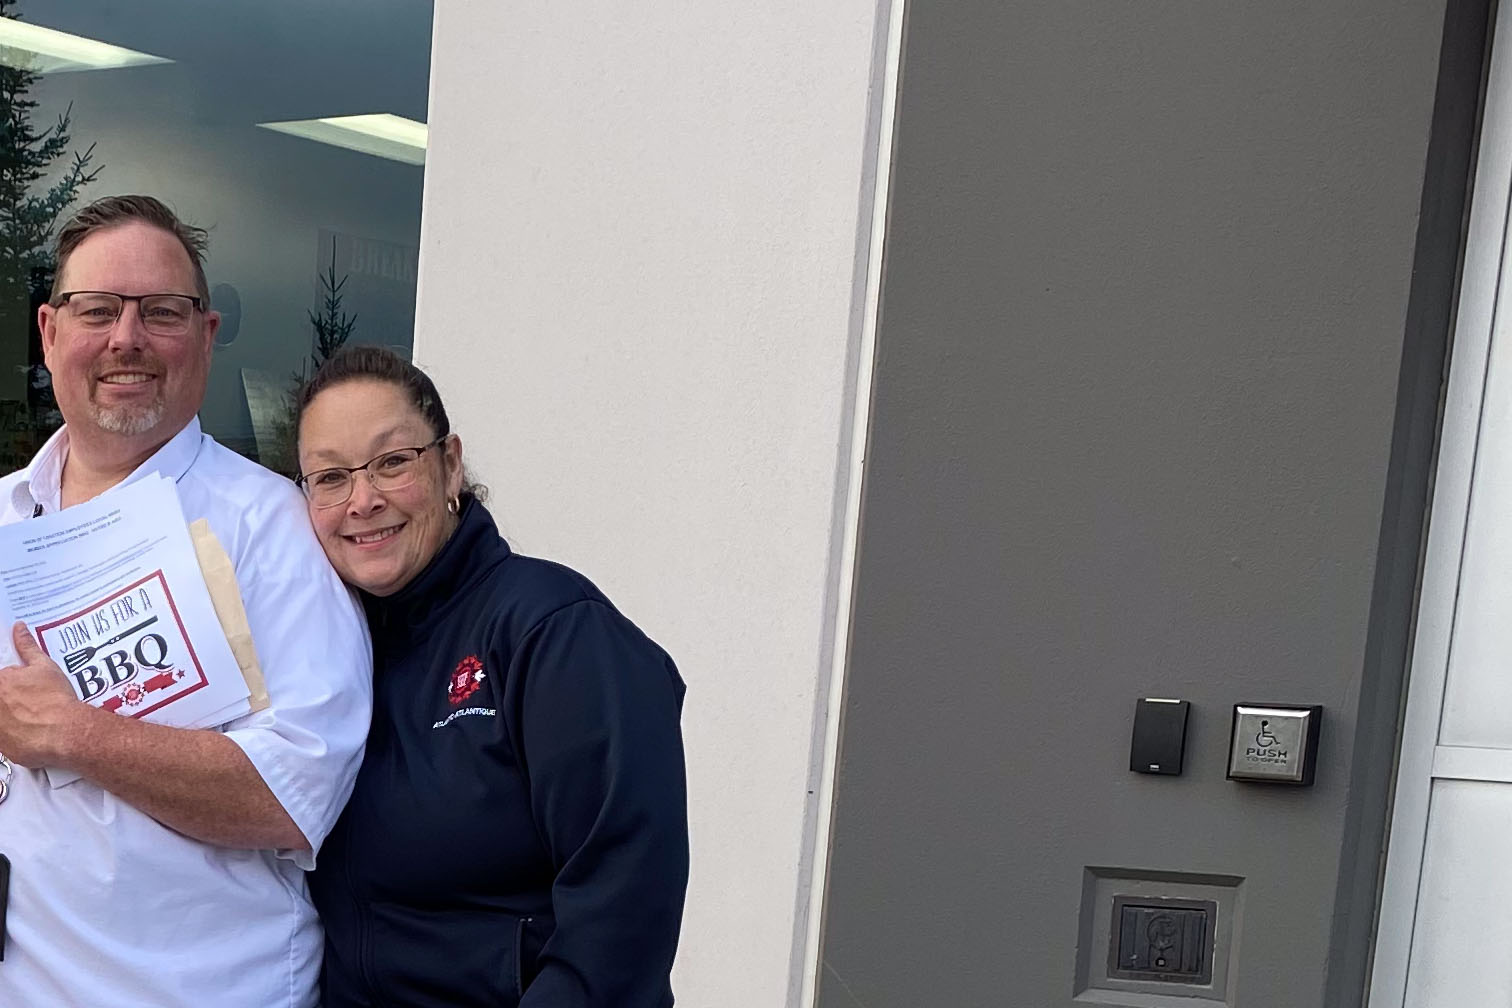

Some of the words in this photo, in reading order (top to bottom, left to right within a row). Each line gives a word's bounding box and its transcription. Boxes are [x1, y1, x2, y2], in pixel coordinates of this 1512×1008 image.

[59, 619, 91, 653] JOIN
[91, 609, 110, 636] US
[110, 595, 139, 625] FOR
[139, 588, 152, 610] A
[71, 633, 175, 703] BBQ
[1246, 748, 1287, 758] PUSH
